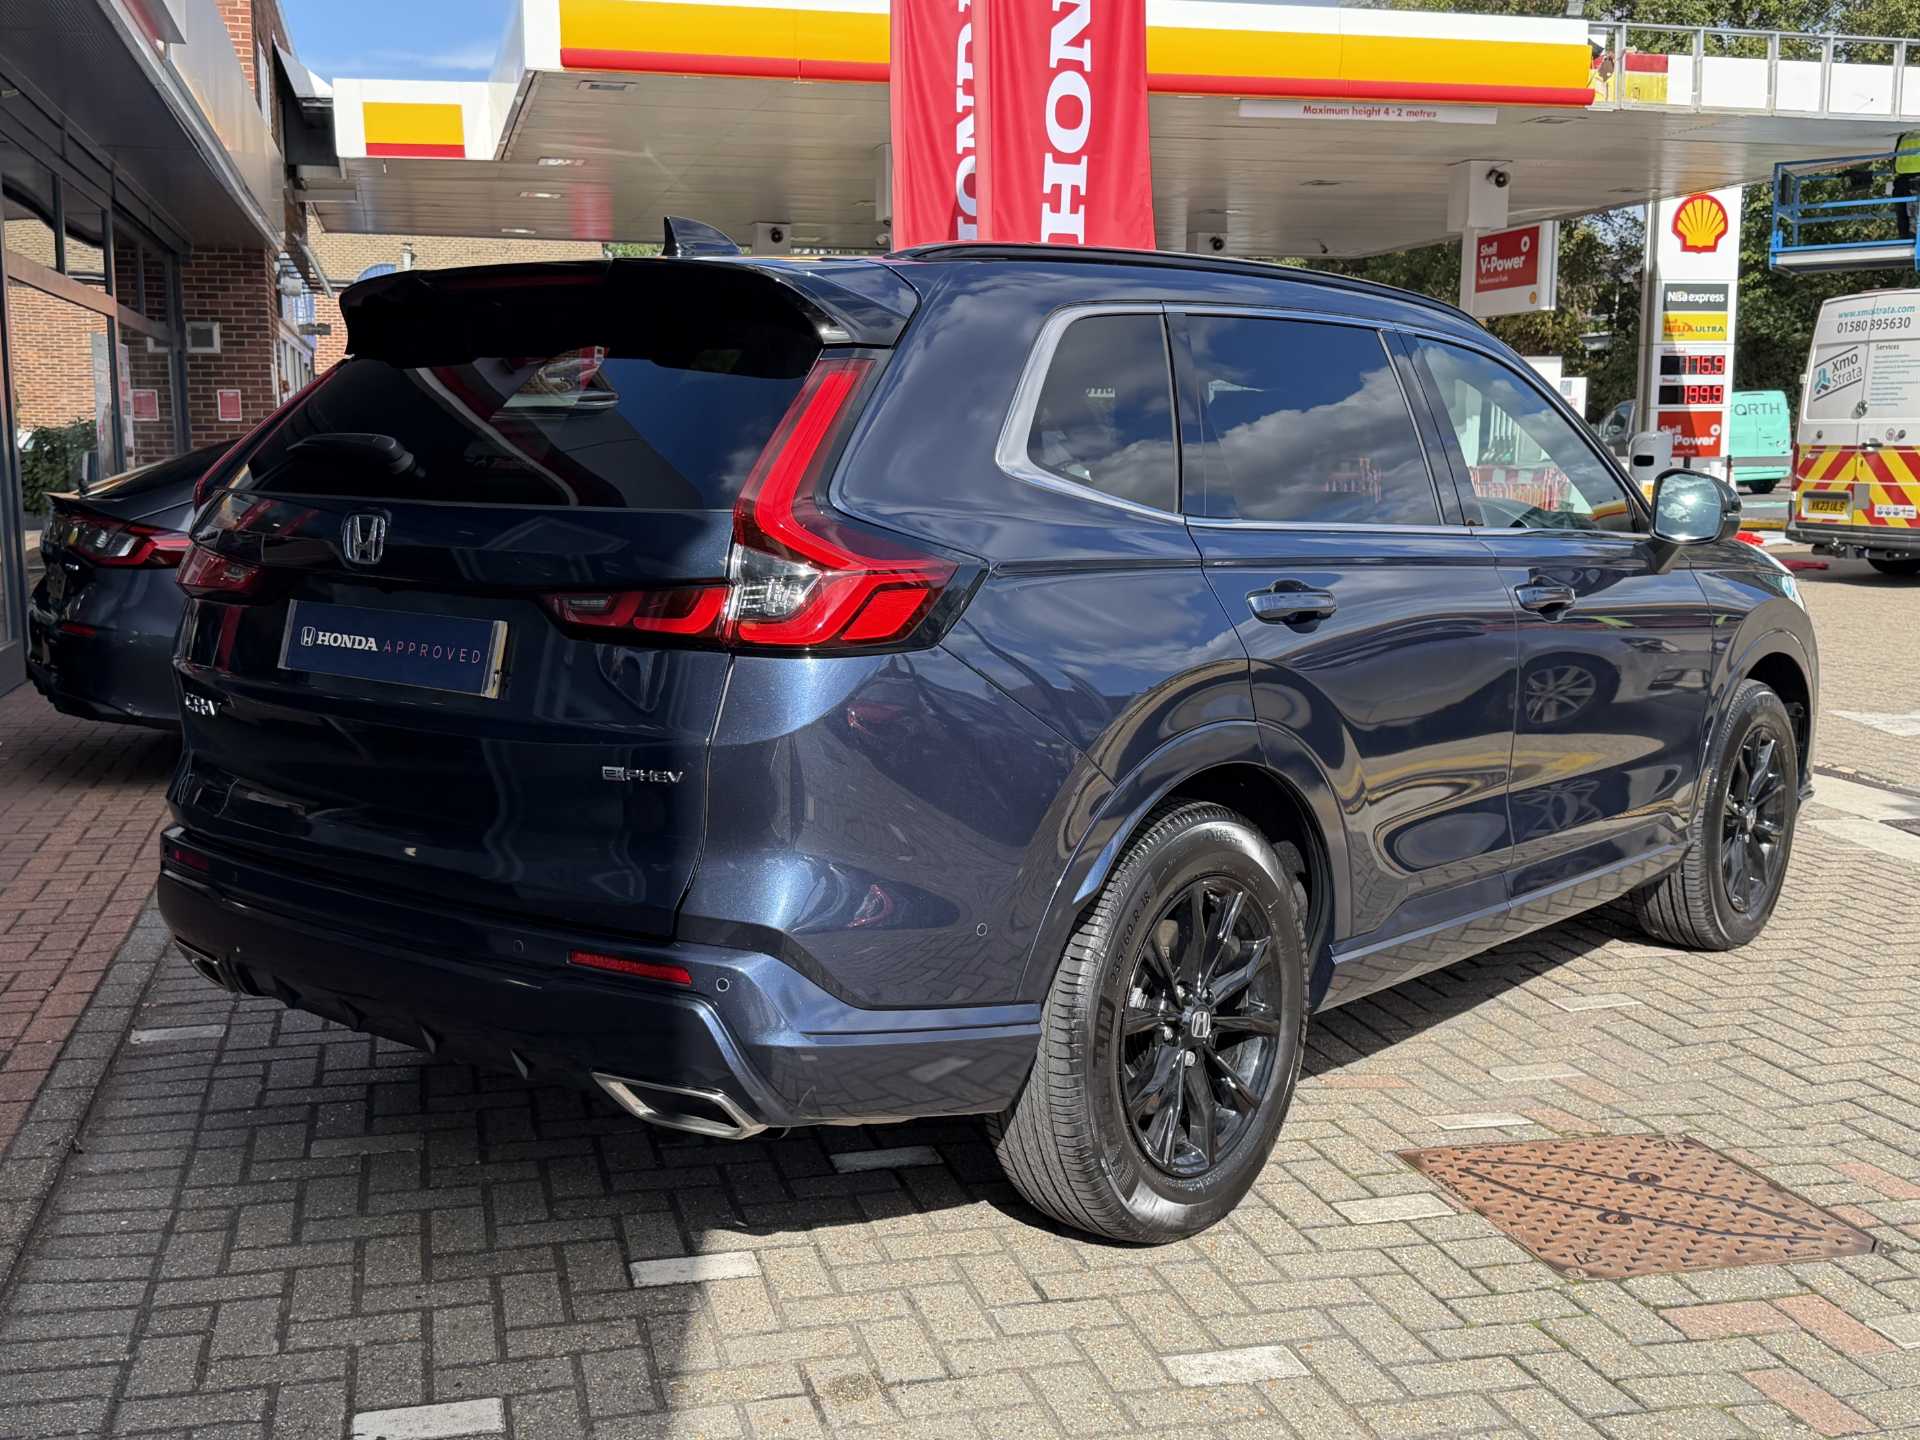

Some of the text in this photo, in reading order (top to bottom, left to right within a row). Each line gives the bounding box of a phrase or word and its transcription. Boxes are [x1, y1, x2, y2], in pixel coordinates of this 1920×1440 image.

[1303, 105, 1350, 115] Maximum
[1352, 106, 1381, 118] height
[1406, 109, 1437, 118] metres
[1480, 241, 1498, 256] Shell
[1480, 255, 1526, 274] V-Power
[1688, 293, 1725, 304] express
[1695, 325, 1724, 333] ULTRA
[1836, 316, 1911, 334] 01580 895630
[1876, 343, 1900, 351] Services
[1832, 353, 1858, 374] Xmo
[1831, 366, 1863, 389] Strata
[1684, 385, 1724, 404] 199.9
[1730, 402, 1780, 416] ORTH
[1674, 435, 1717, 446] Power
[316, 631, 378, 651] HONDA
[383, 640, 481, 664] APPROVED
